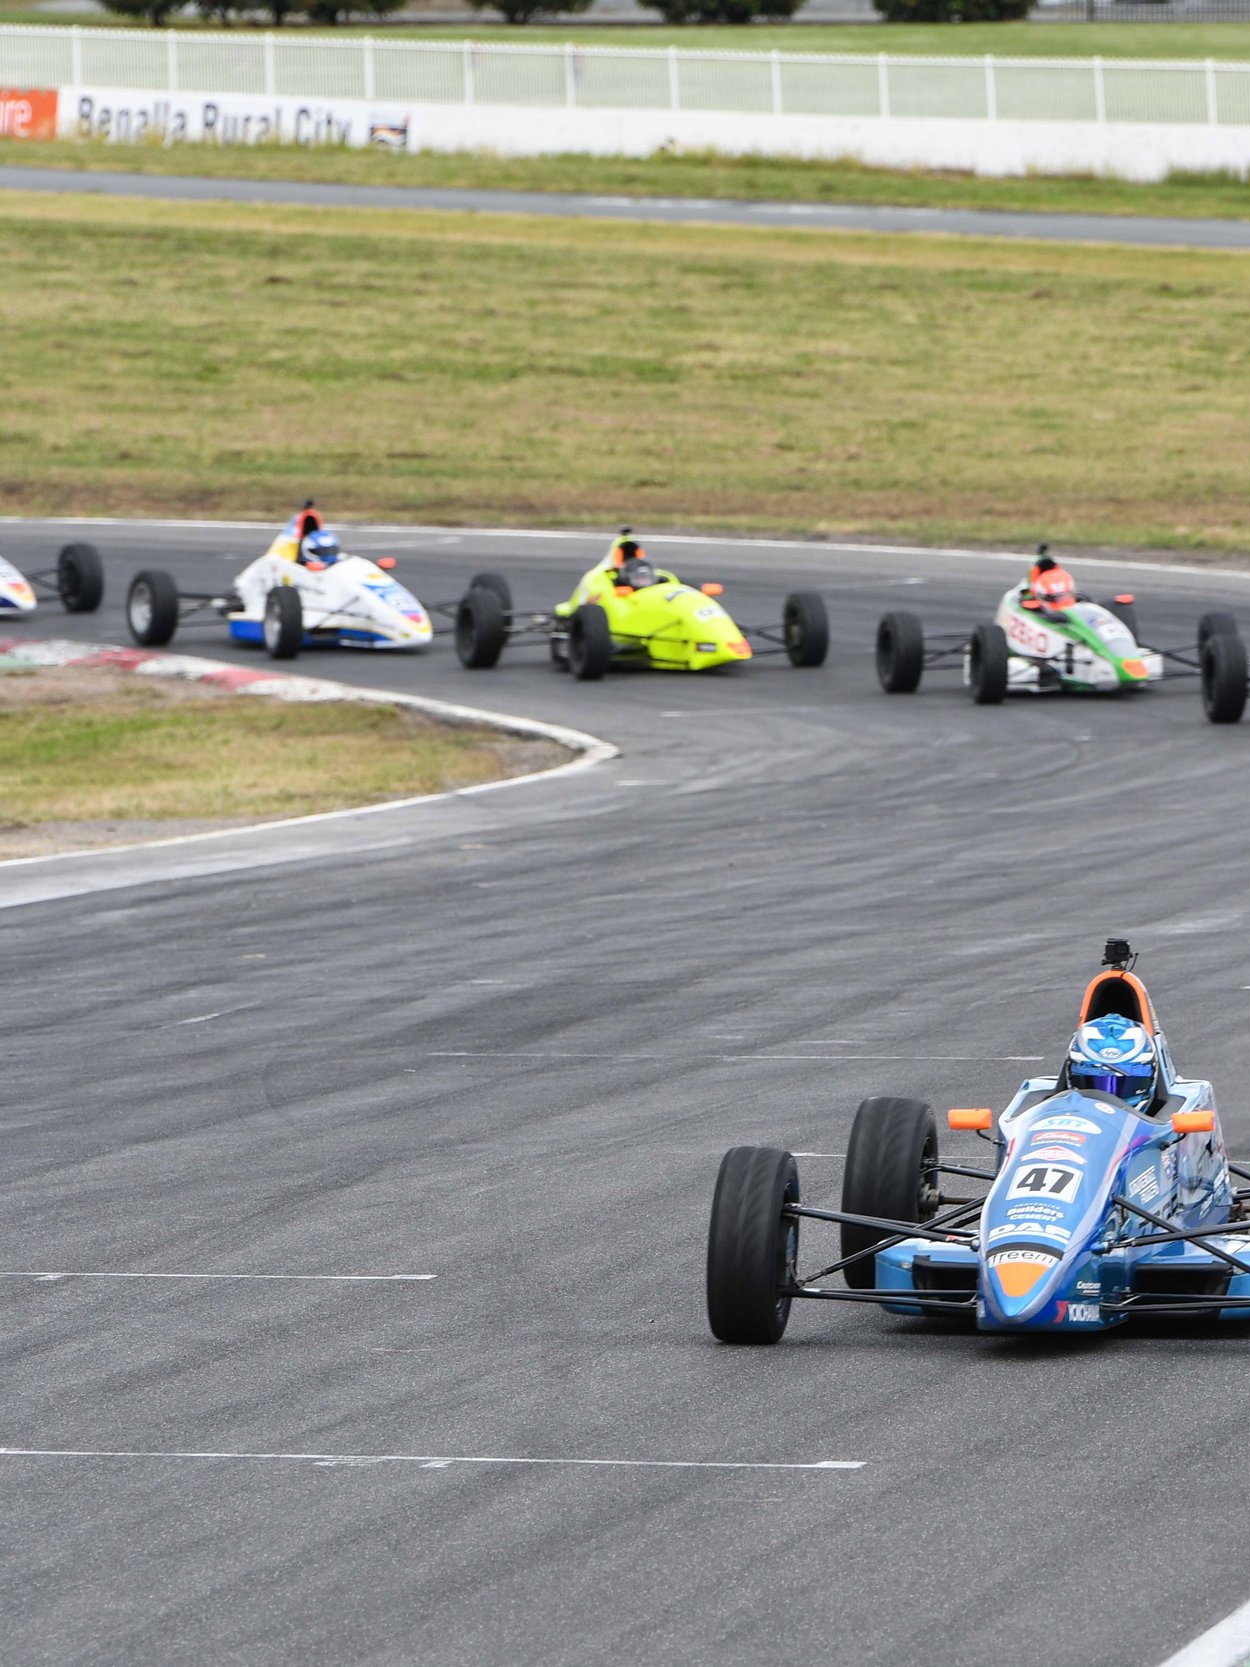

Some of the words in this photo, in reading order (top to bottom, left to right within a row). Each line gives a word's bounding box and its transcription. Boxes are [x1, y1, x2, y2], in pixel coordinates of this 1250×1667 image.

[79, 96, 187, 142] Benalla
[203, 103, 282, 146] Rural
[296, 108, 353, 146] City
[1016, 1167, 1074, 1194] 47
[1006, 1205, 1065, 1219] Builders
[989, 1222, 1072, 1239] DAF
